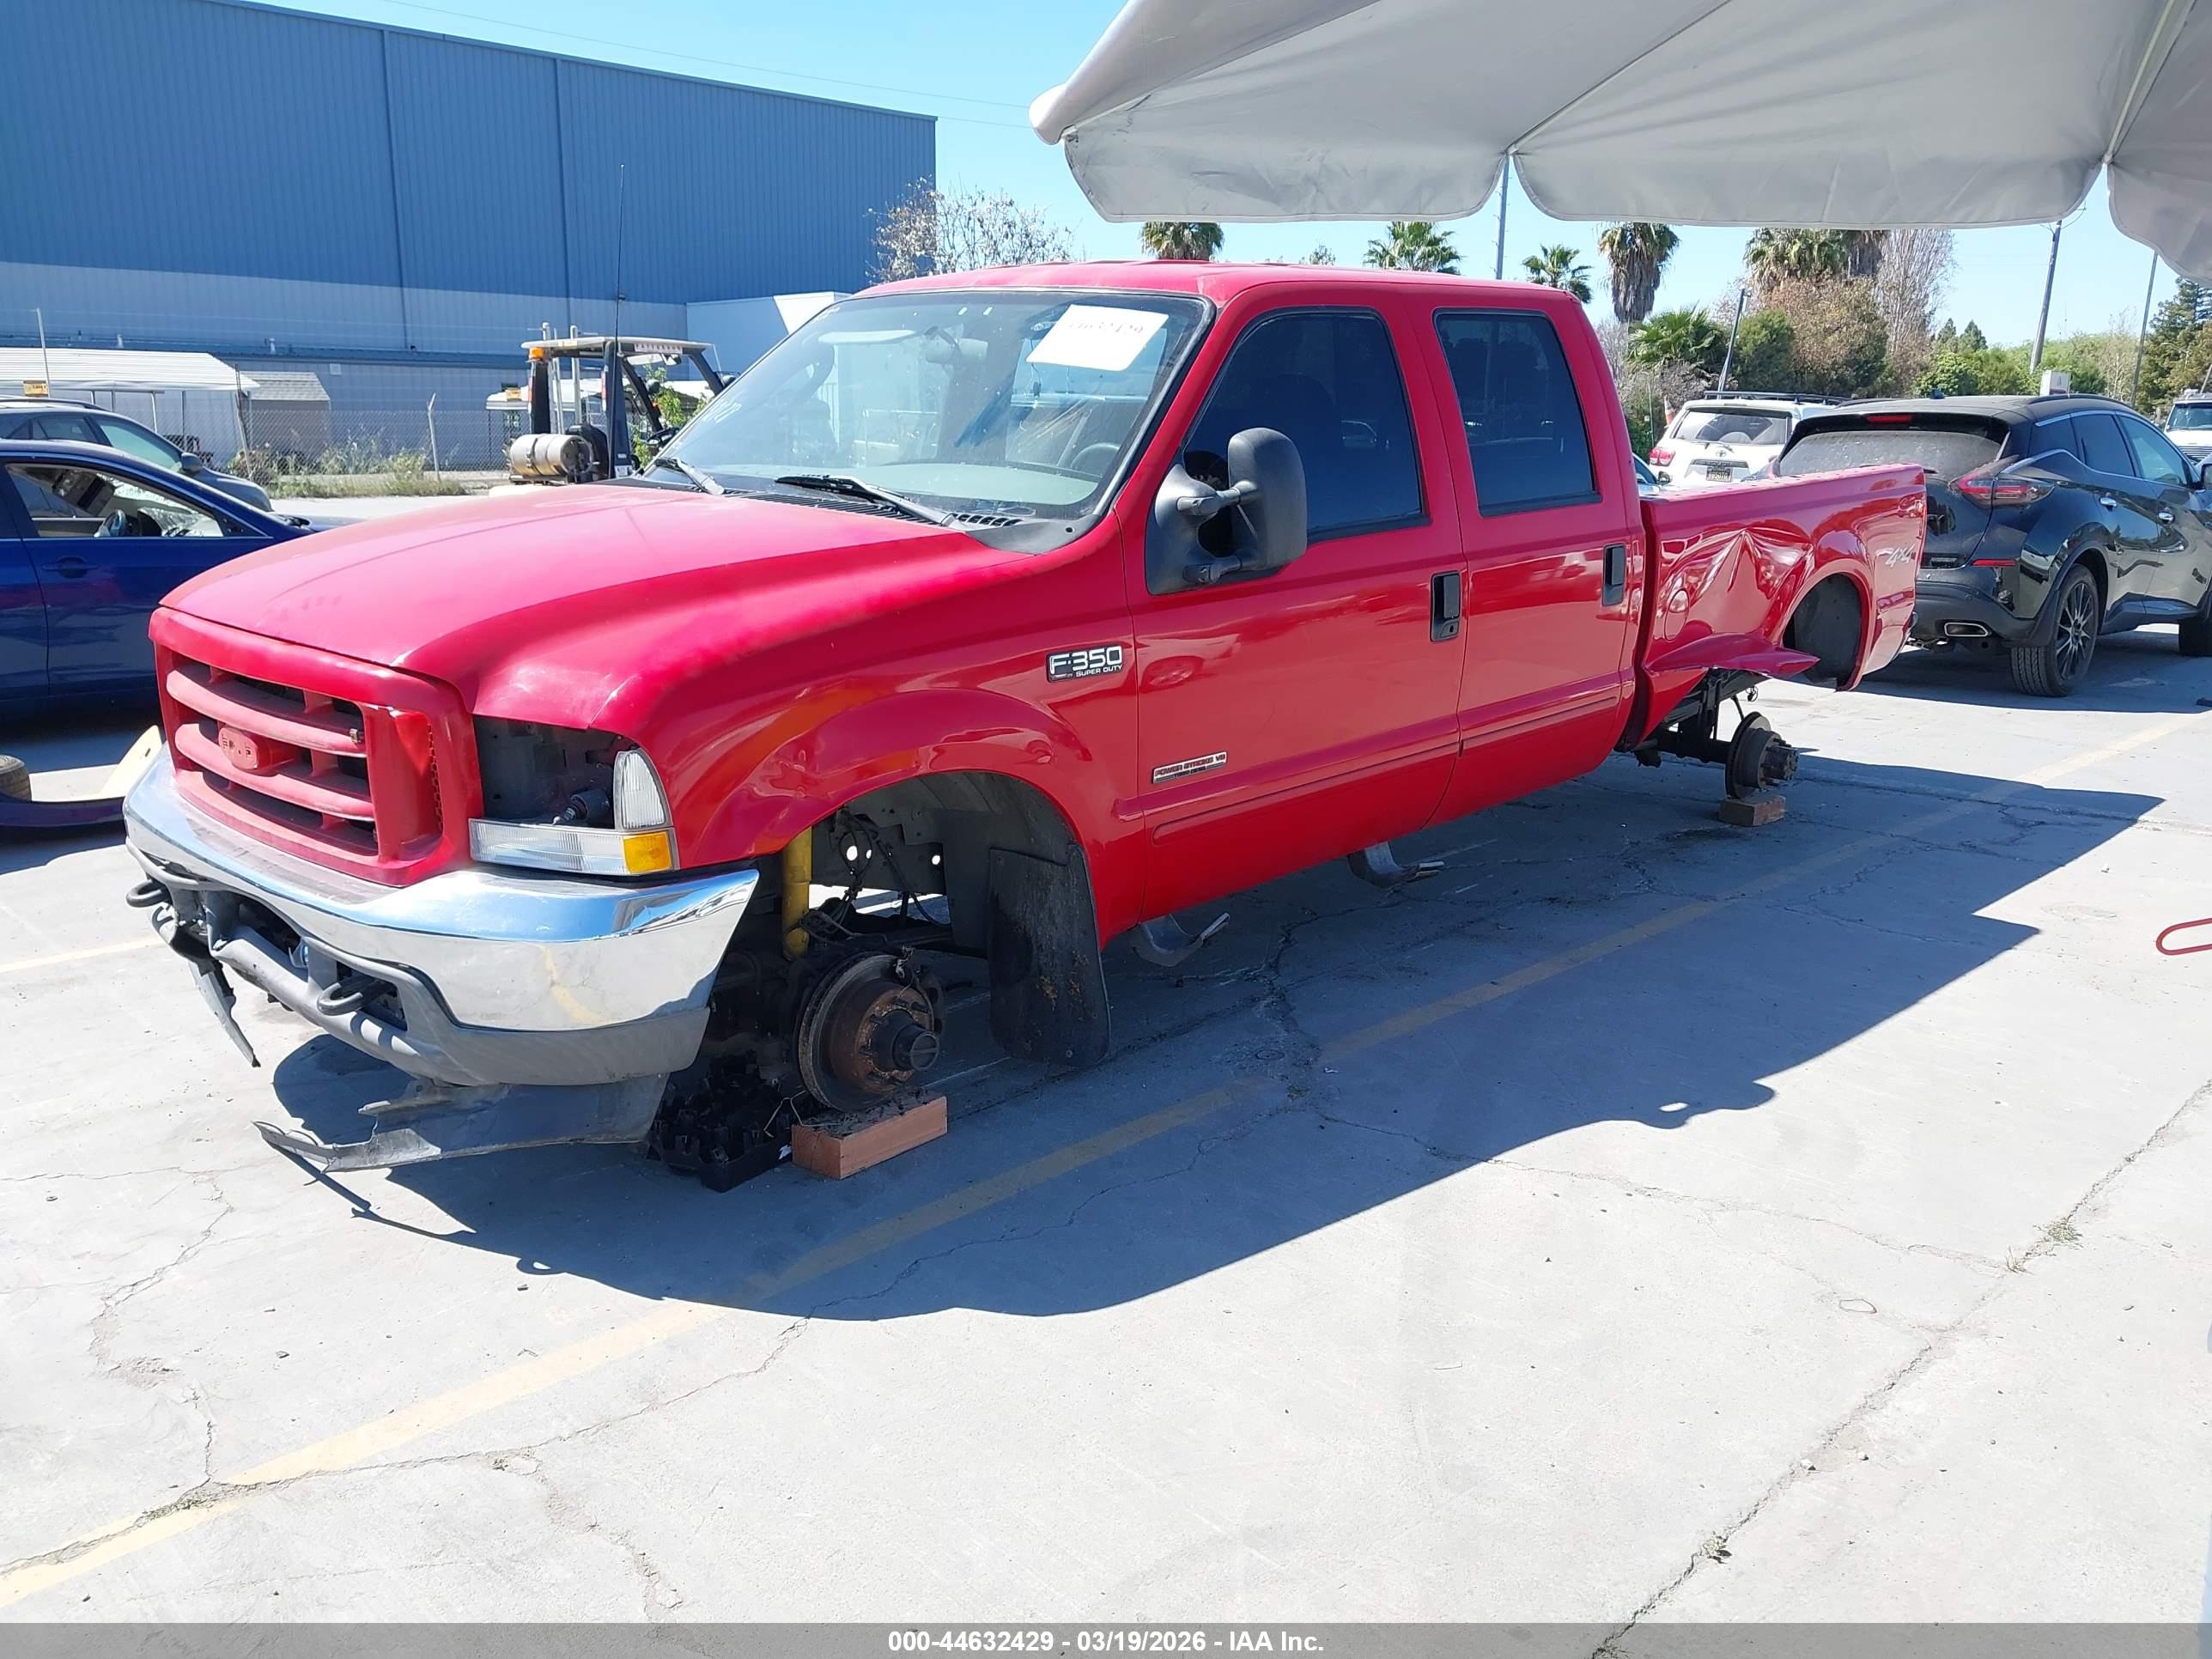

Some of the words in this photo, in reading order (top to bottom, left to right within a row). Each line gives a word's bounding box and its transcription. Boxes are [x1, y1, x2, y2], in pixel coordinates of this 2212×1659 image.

[1076, 668, 1101, 678] SUPER
[1103, 664, 1123, 672] DUTY
[1154, 764, 1183, 777] POWER
